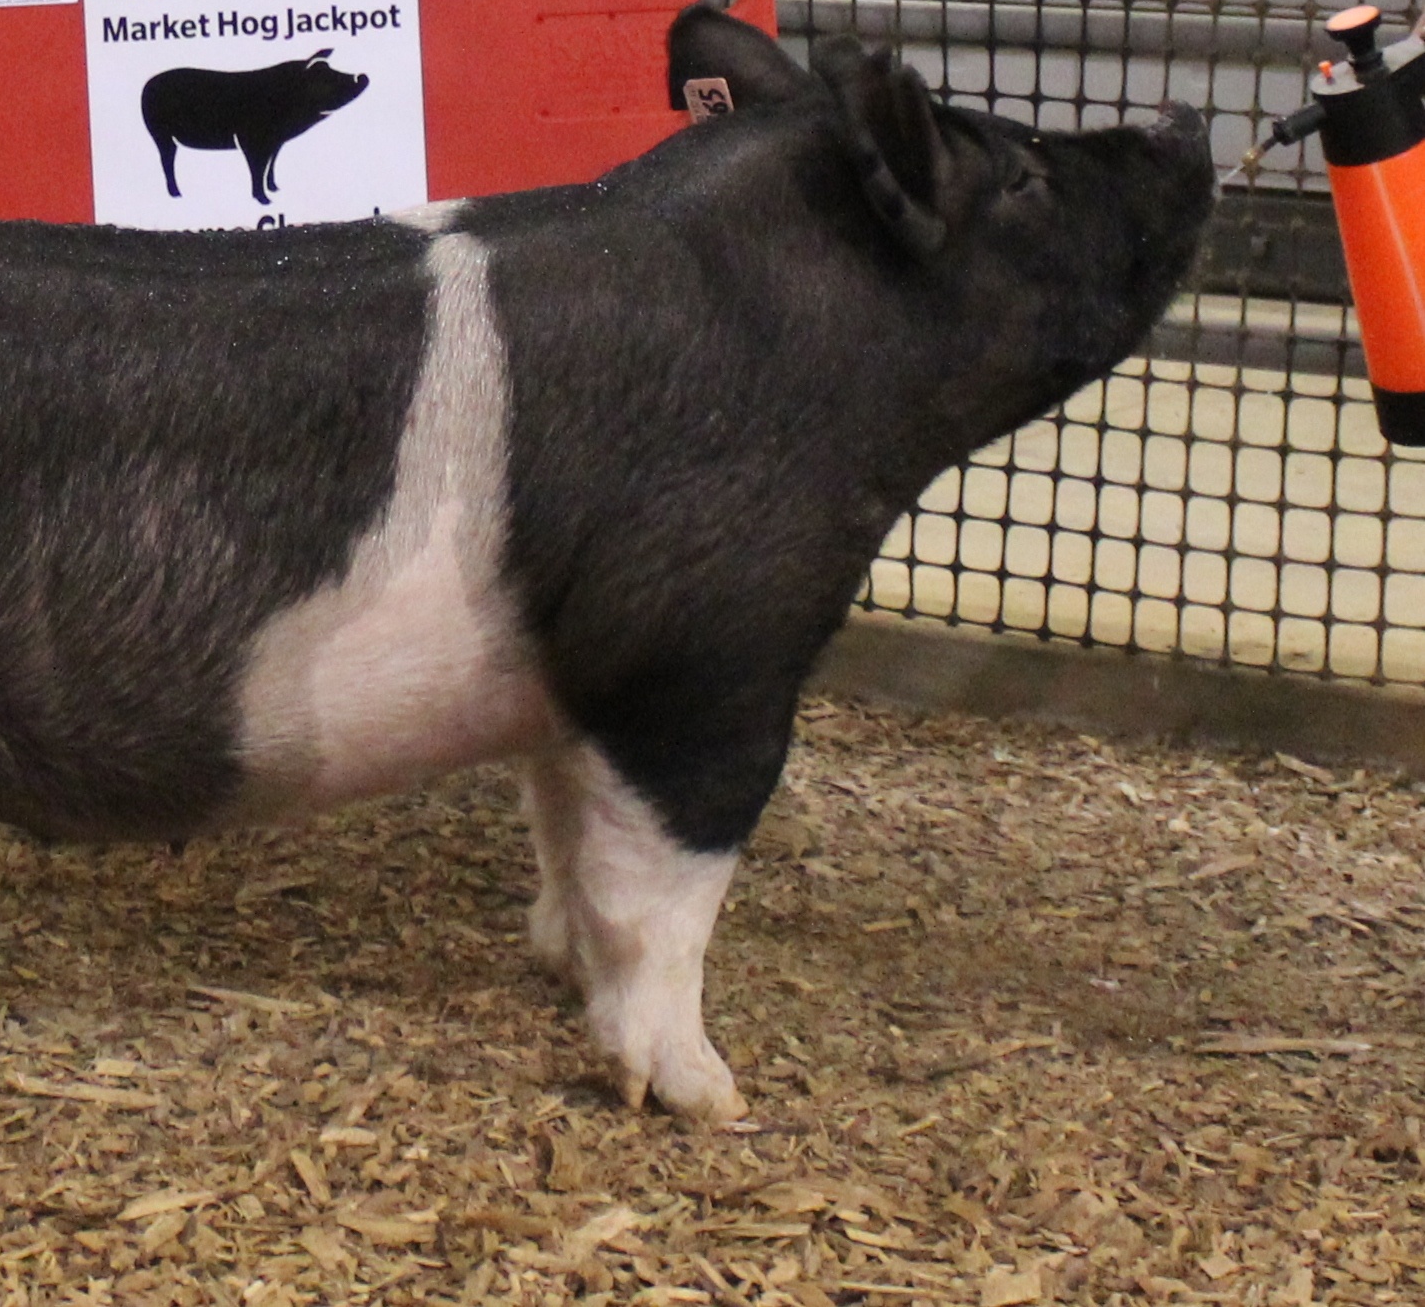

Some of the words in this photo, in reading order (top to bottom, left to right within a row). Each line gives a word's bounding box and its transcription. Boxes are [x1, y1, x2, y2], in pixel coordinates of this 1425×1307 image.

[103, 13, 210, 42] Market
[218, 10, 278, 40] Hog
[284, 4, 401, 39] Jackpot
